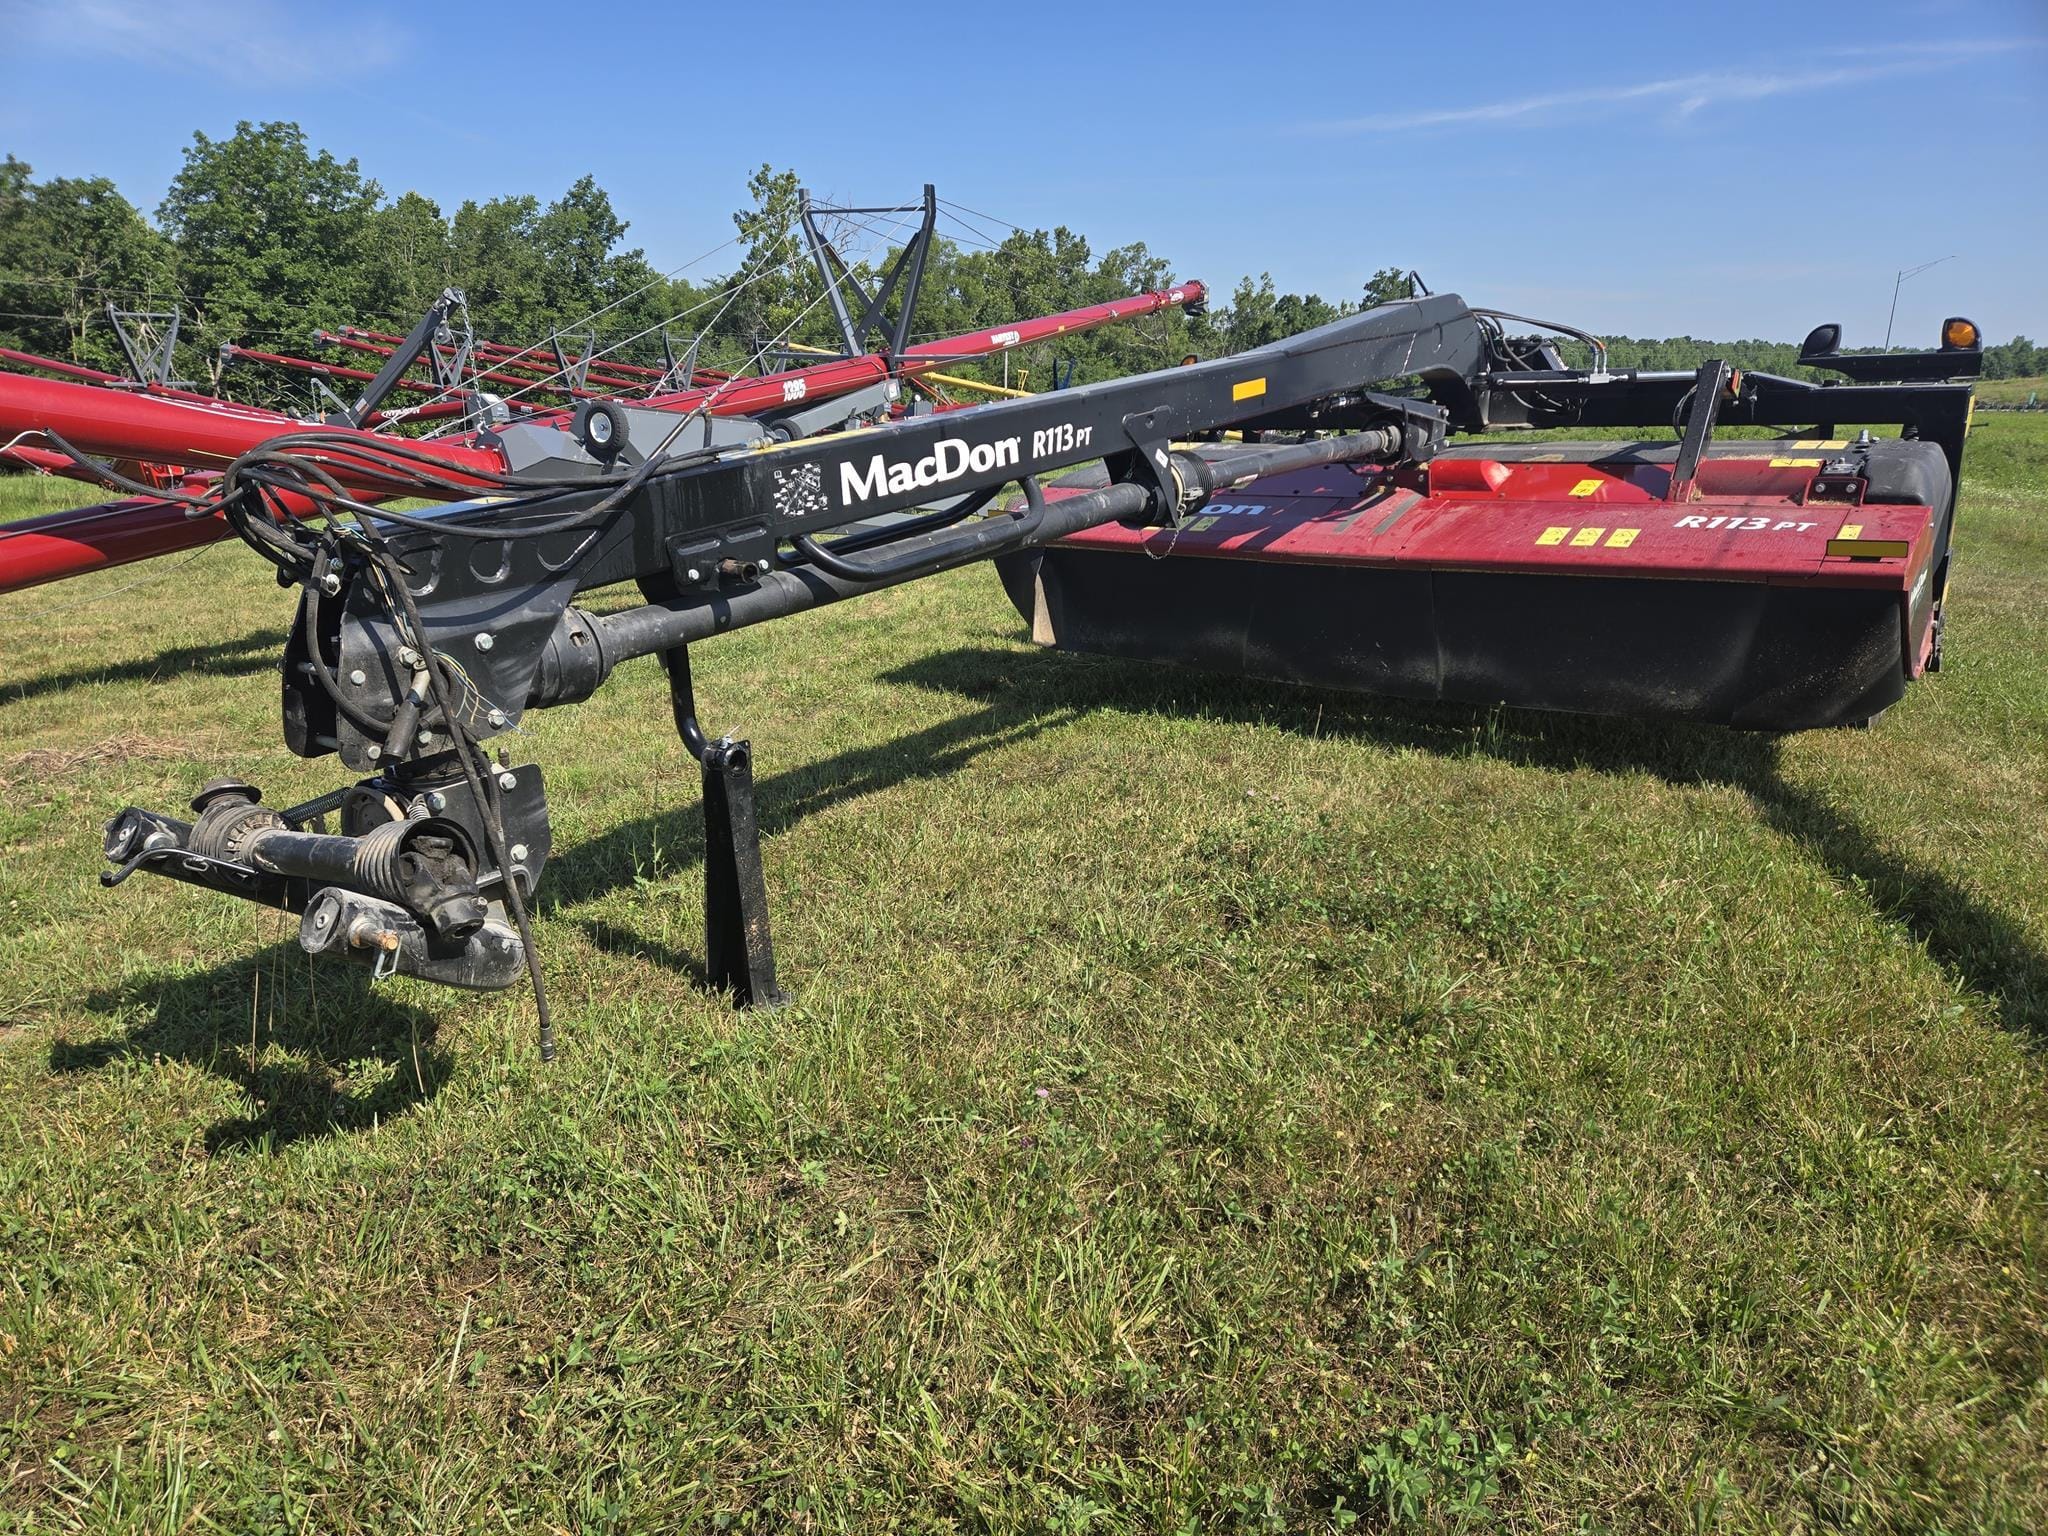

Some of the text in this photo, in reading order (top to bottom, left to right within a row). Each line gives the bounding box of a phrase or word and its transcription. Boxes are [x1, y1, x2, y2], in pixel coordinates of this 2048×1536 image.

[839, 423, 1093, 506] MacDon R113 PT
[1673, 515, 1818, 532] R113 PT
